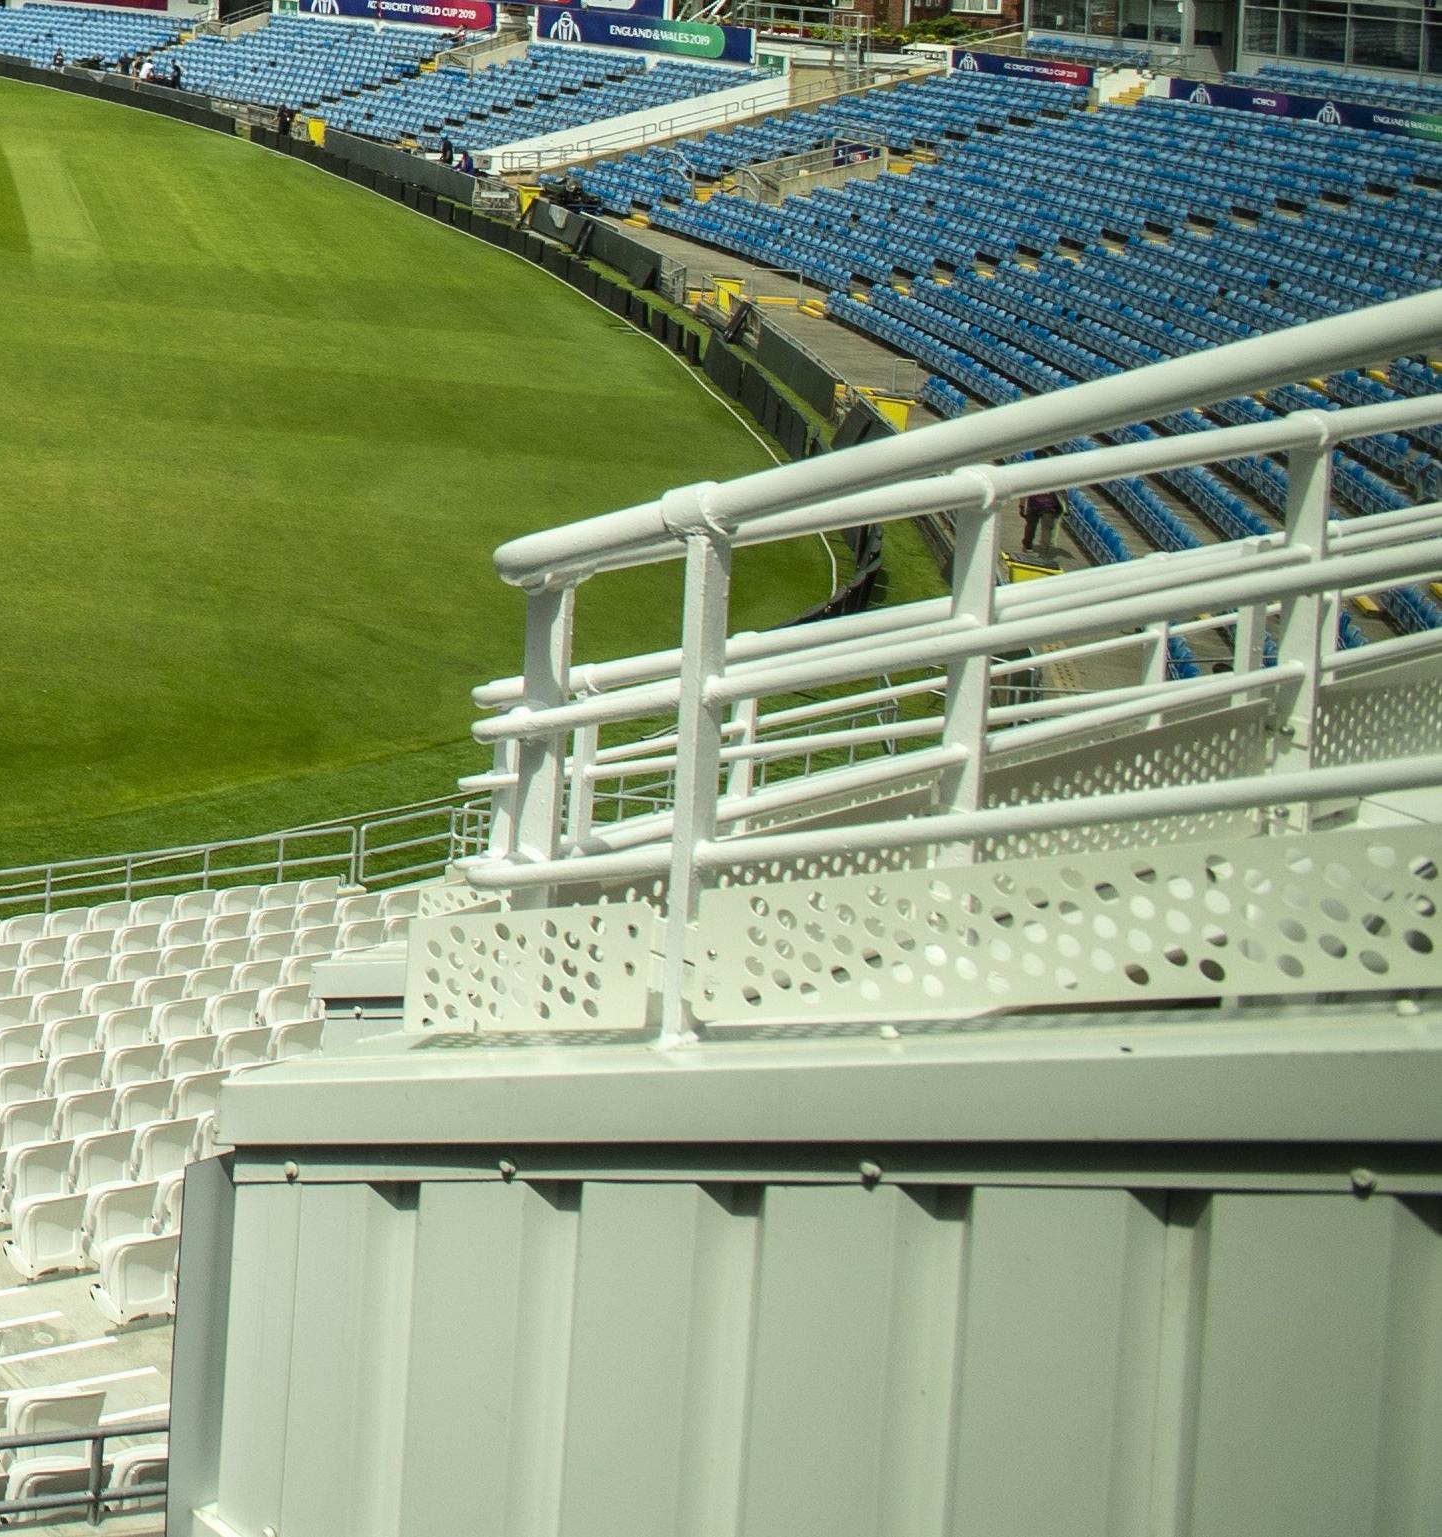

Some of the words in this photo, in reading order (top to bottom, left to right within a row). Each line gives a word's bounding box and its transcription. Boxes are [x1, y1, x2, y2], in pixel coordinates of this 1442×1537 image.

[380, 1, 411, 12] CRICKET
[412, 4, 441, 16] WORLD
[442, 7, 457, 17] CUP
[458, 9, 477, 20] 2019
[610, 25, 652, 39] ENGLAND
[660, 30, 689, 44] WALES
[690, 33, 710, 46] 2019
